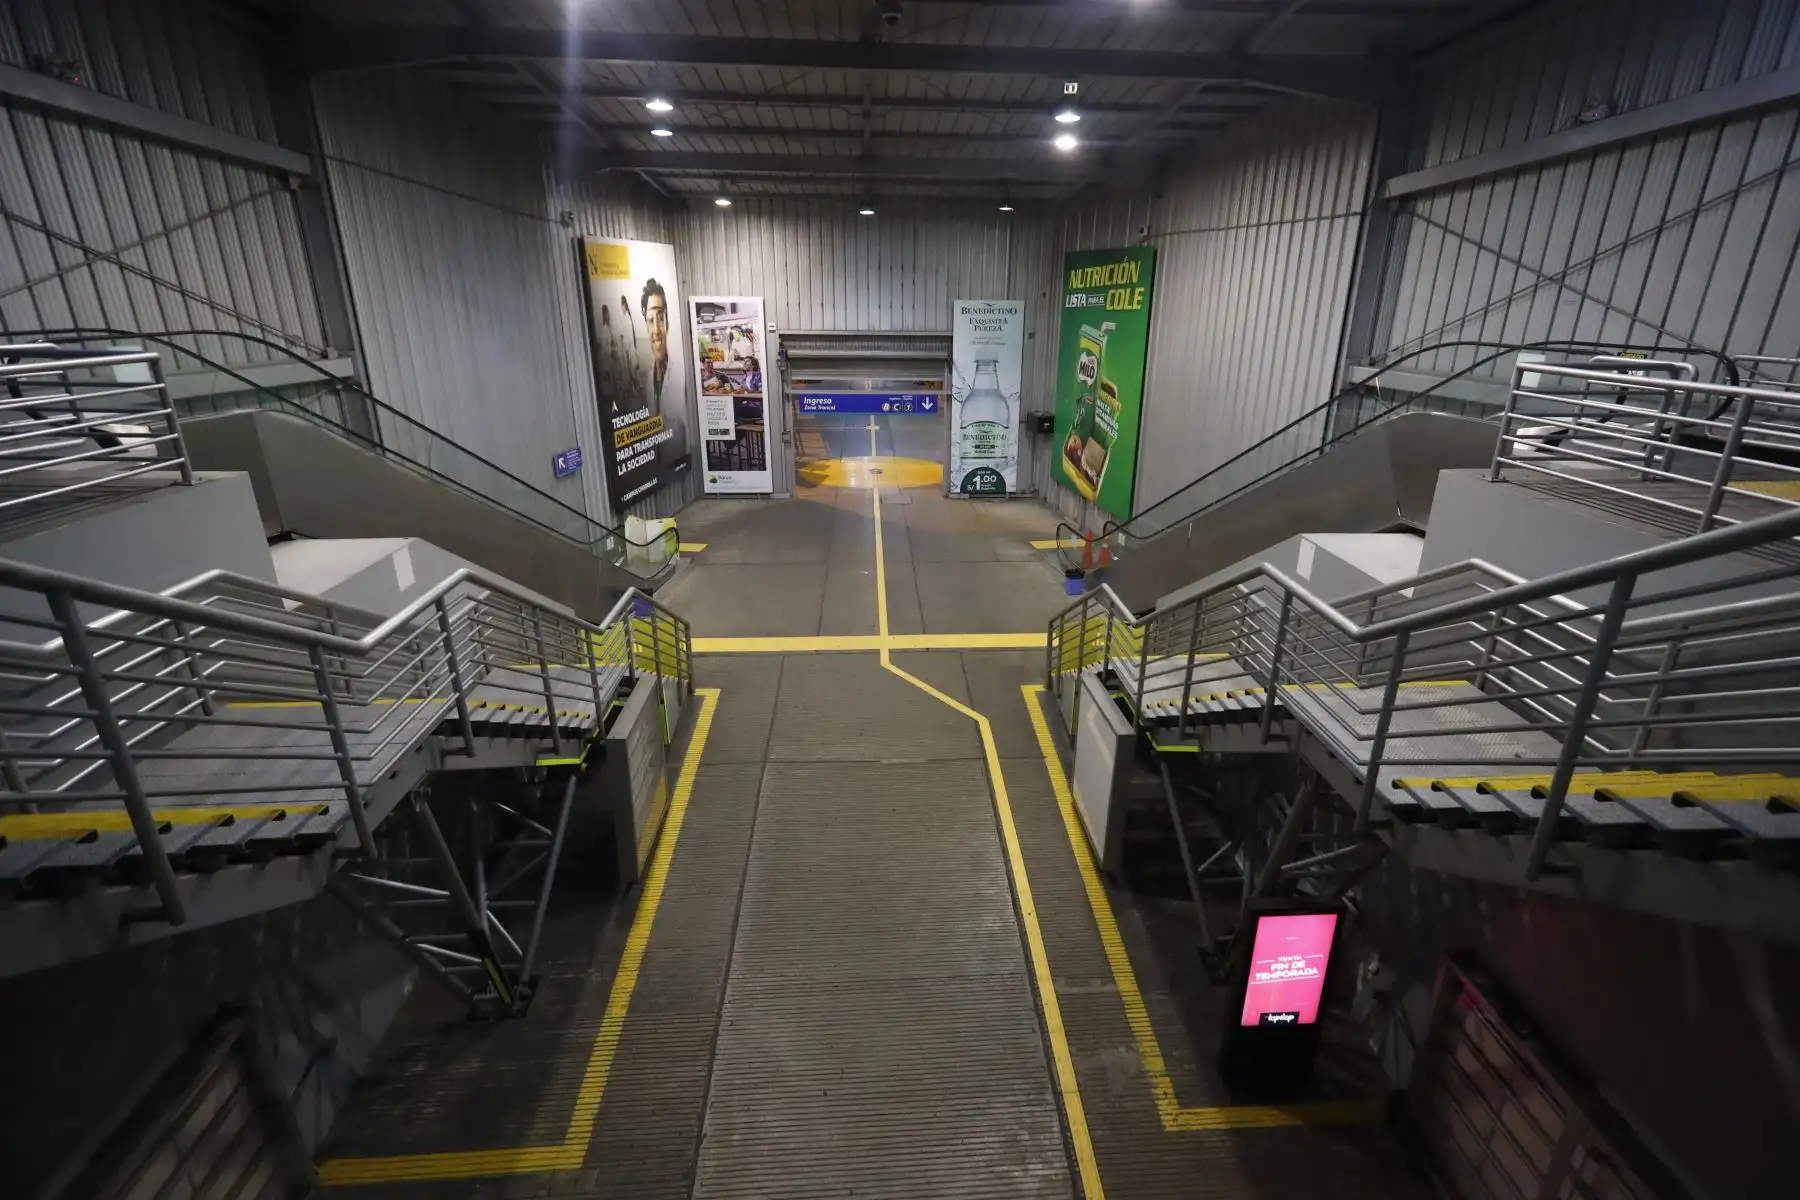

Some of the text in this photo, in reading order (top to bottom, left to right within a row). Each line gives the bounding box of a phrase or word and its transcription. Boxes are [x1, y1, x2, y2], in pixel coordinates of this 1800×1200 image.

[1069, 256, 1141, 289] NUTRICIÓN
[1065, 294, 1086, 307] LISTA
[1106, 287, 1144, 311] COLE
[1079, 361, 1095, 379] MILO
[803, 396, 832, 405] Ingreso
[612, 405, 650, 430] TECNOLOGÍA
[616, 418, 663, 445] DE VANGUARDIA
[616, 429, 673, 462] PARA TRANSFORMAR
[618, 463, 627, 476] LA
[627, 450, 655, 471] SOCIEDAD
[1255, 967, 1318, 981] TEMPORADA
[1271, 960, 1306, 971] FIN DE
